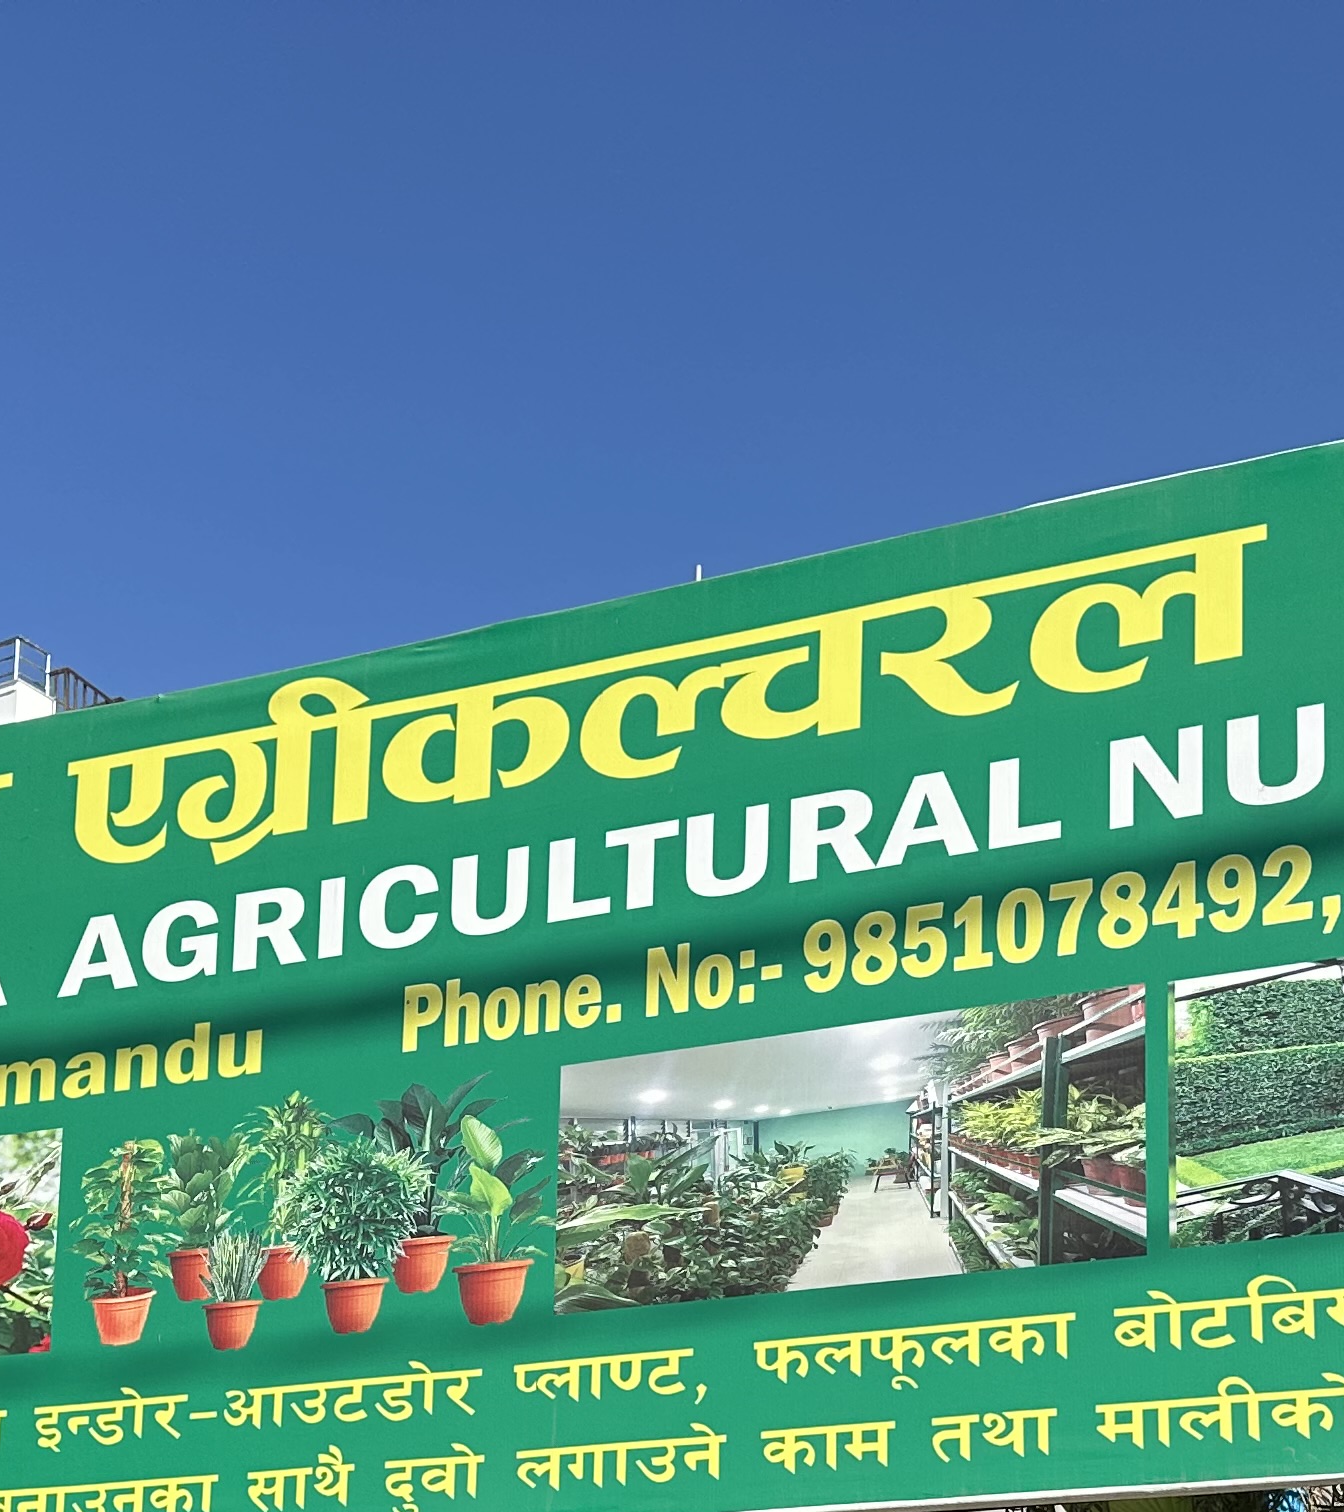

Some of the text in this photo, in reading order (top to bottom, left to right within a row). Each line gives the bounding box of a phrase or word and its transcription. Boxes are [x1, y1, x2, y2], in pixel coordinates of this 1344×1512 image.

[69, 526, 1268, 863] एग्रीकल्चरल
[57, 757, 1062, 999] AGRICULTURAL
[401, 974, 623, 1053] Phone.
[644, 943, 783, 1017] No:-
[802, 845, 1342, 993] 9851078492,
[34, 1360, 483, 1449] इन्डोर-आउटडोर
[513, 1347, 709, 1406] प्लाण्ट,
[754, 1311, 1076, 1391] फलफूलका
[247, 1445, 355, 1510] साथै
[515, 1424, 728, 1490] लगाउने
[761, 1418, 897, 1475] काम
[931, 1407, 1058, 1464] तथा
